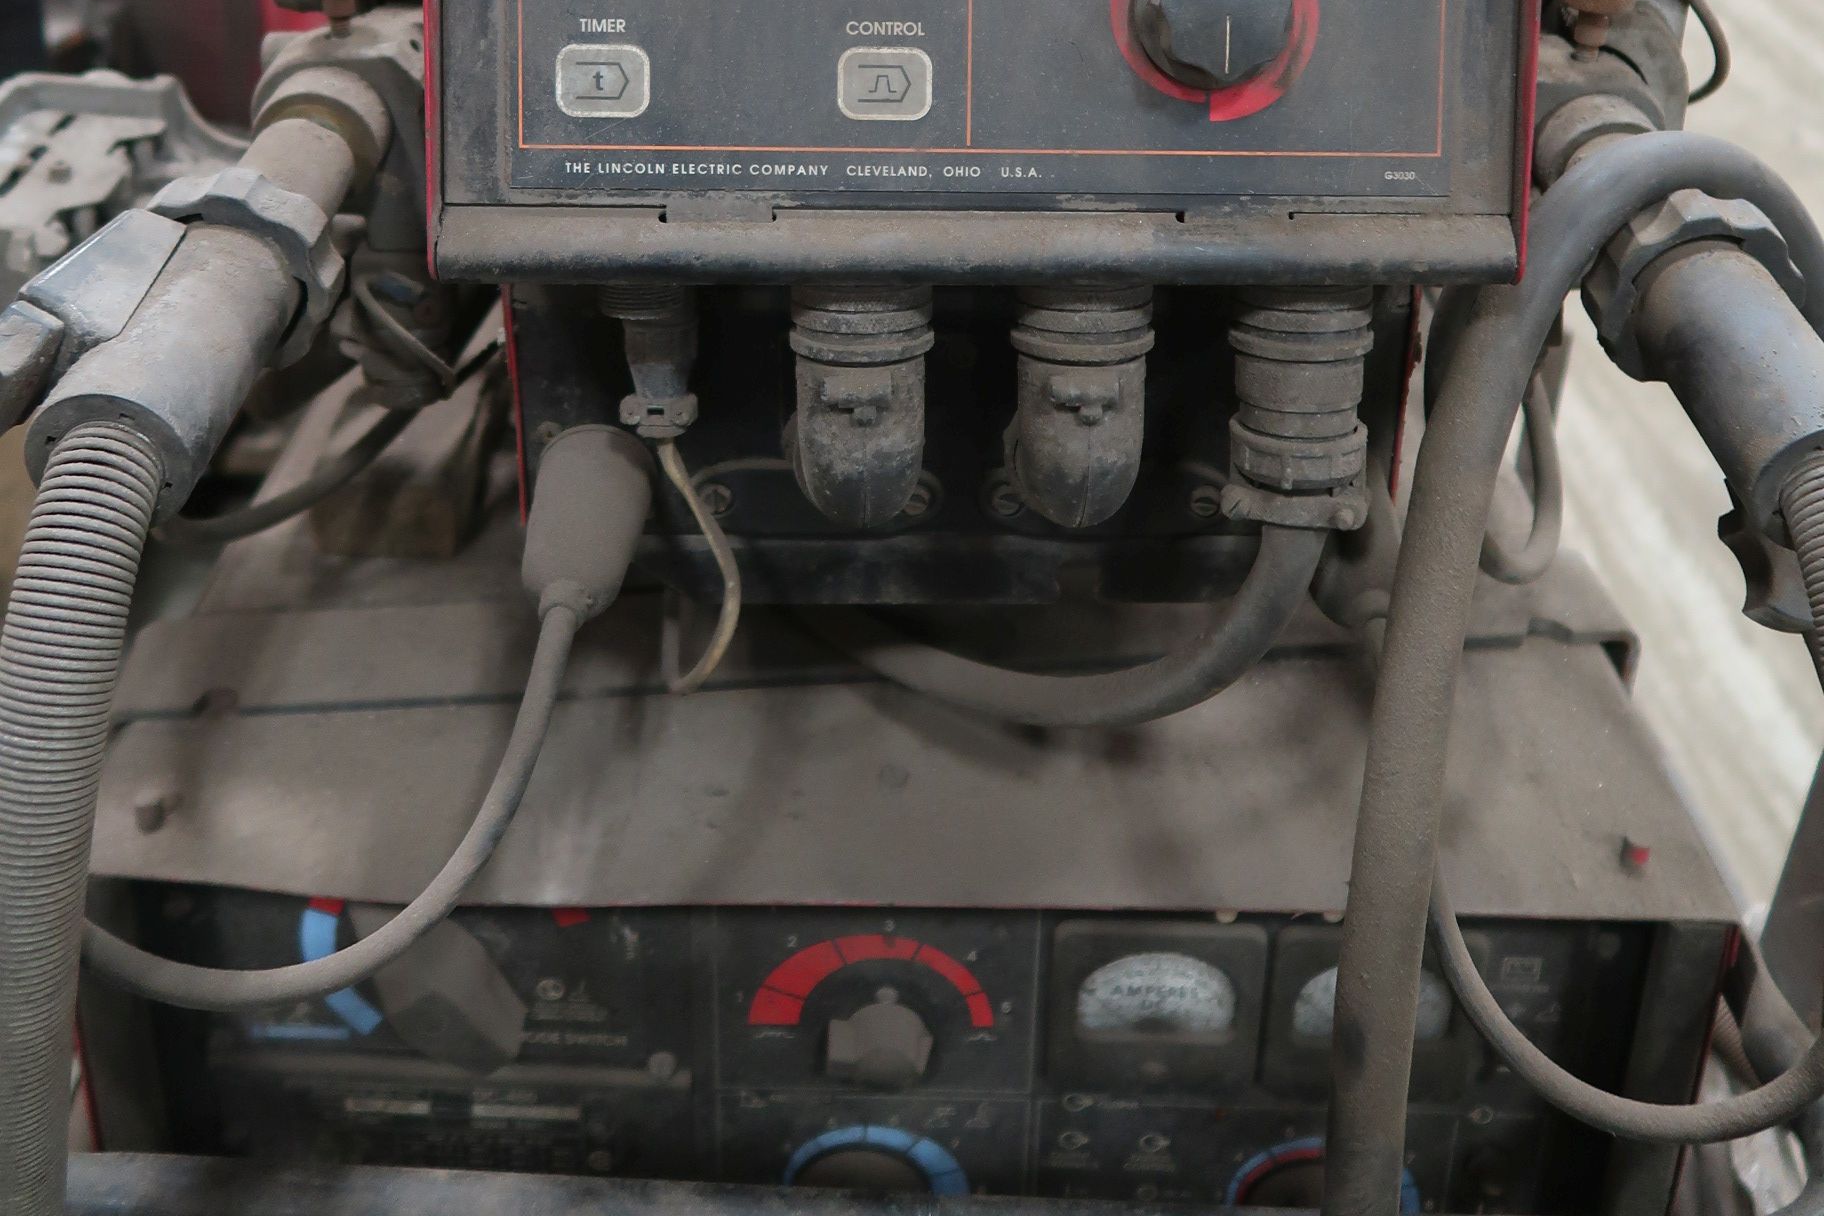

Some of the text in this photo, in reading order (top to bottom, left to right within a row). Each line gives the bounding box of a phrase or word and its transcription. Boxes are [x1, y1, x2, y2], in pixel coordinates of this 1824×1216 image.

[580, 18, 626, 34] TIMER
[846, 21, 925, 36] CONTROL
[565, 162, 1043, 179] THE LINCOLN ELECTRIC COMPANY CLEVELAND, OHIO U.S.A.
[787, 936, 798, 948] 2
